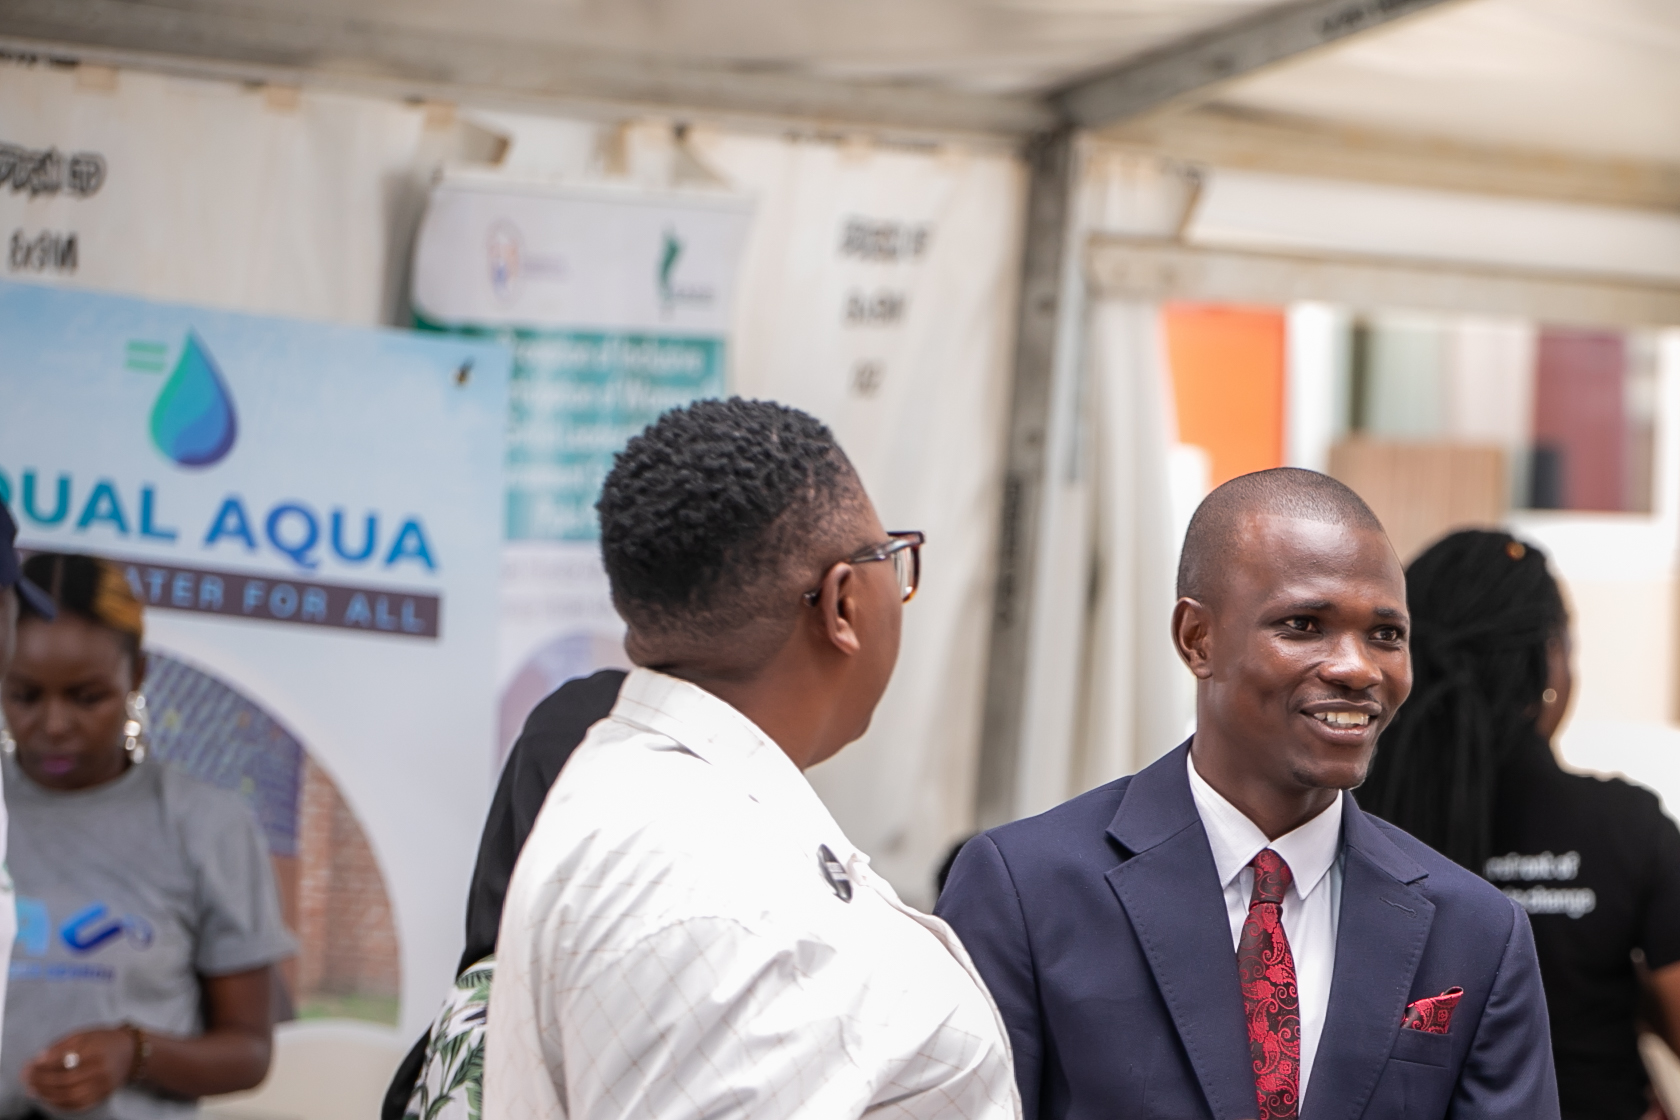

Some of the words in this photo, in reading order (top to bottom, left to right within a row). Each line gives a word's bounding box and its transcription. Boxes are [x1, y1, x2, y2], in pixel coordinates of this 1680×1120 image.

[0, 467, 178, 541] UAL
[203, 494, 438, 574] AQUA
[242, 580, 328, 622] FOR
[344, 594, 427, 634] ALL
